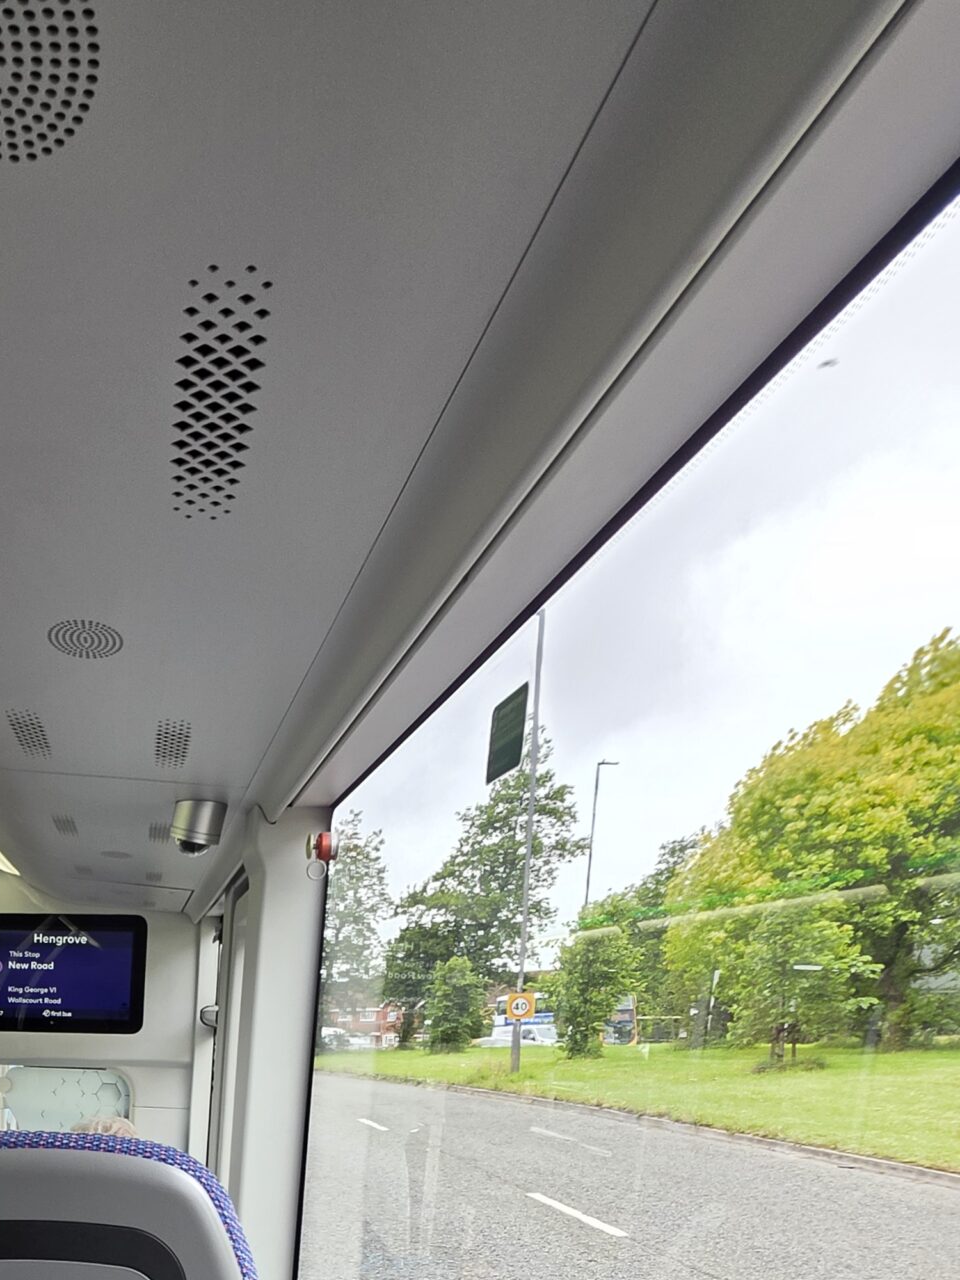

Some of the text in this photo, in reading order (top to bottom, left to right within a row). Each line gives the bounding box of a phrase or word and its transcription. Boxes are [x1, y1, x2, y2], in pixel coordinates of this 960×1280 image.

[33, 933, 88, 946] Hengrove
[9, 950, 40, 959] This Stop
[8, 961, 54, 970] New Road
[7, 986, 23, 994] King
[24, 986, 48, 994] George
[7, 996, 43, 1004] Wallscourt
[512, 1002, 528, 1010] 40
